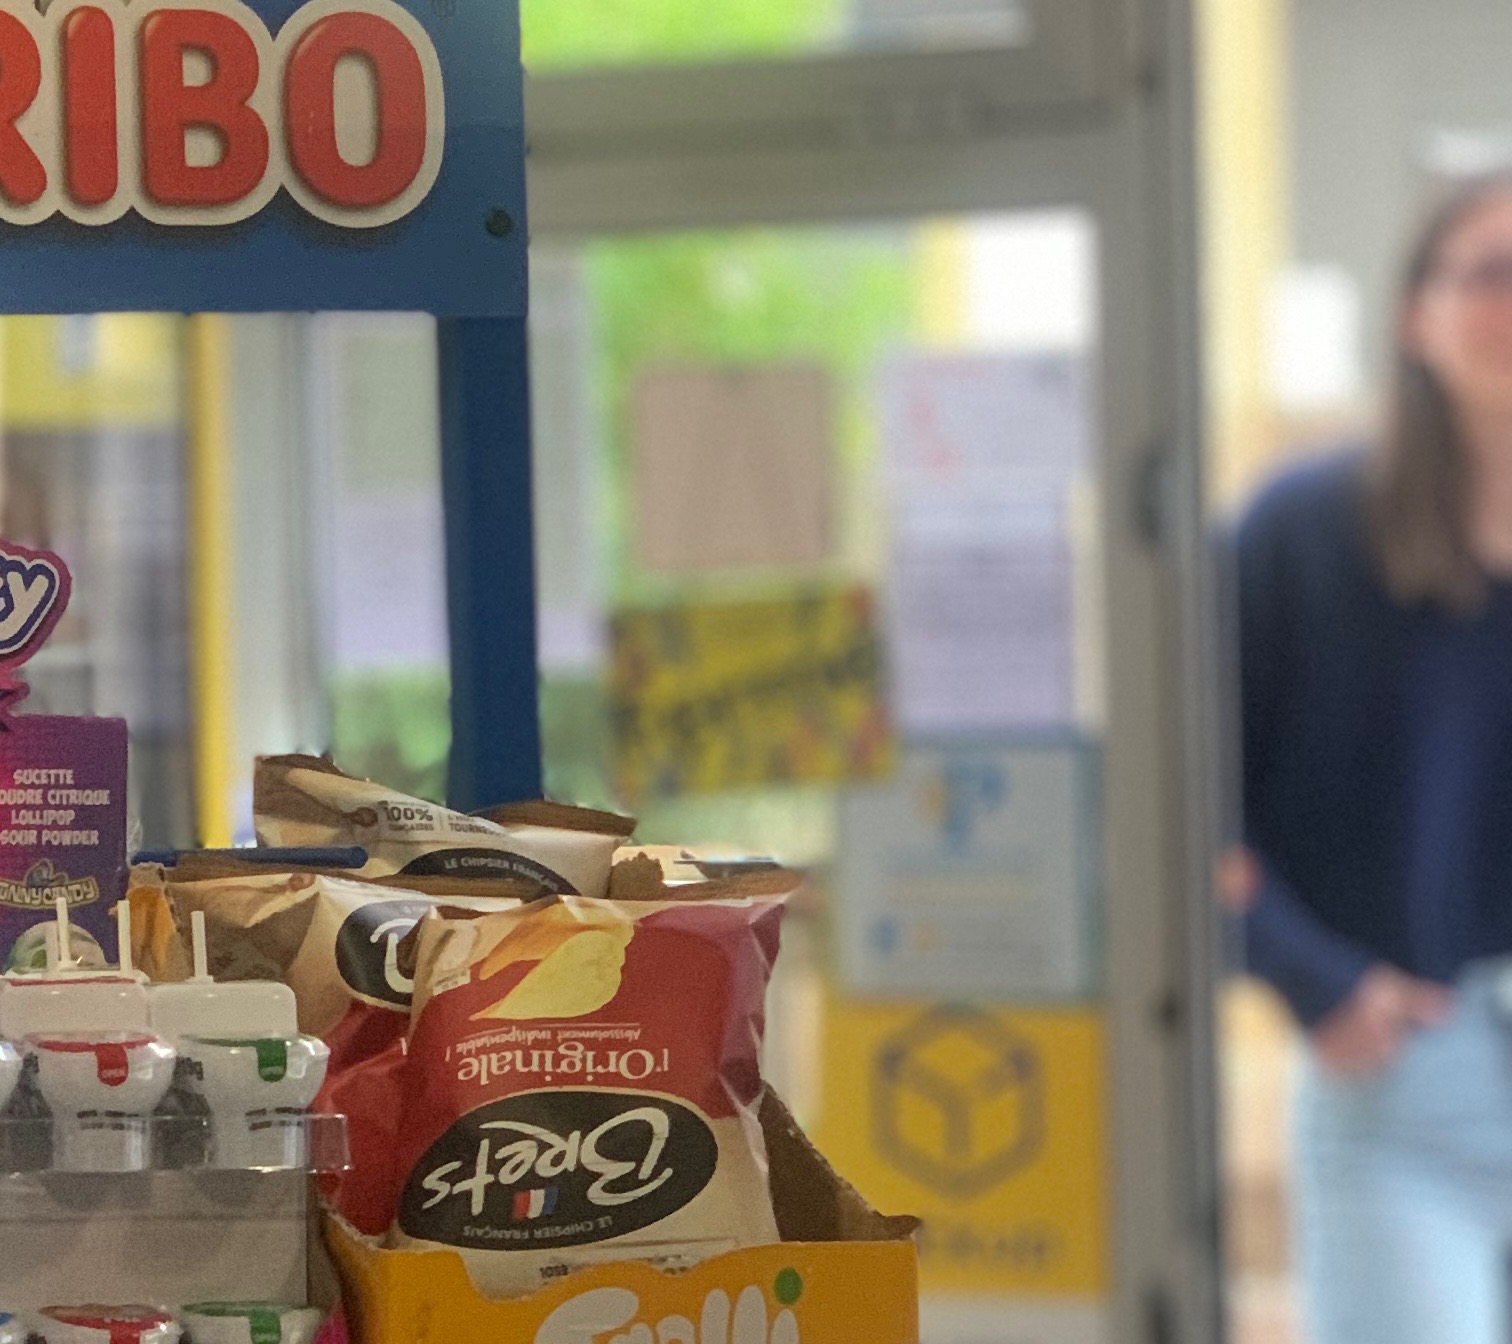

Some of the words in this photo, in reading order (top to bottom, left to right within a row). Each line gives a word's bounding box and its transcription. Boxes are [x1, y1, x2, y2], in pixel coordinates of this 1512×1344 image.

[13, 768, 75, 785] SUCETTE
[47, 789, 110, 805] CITRIQUE
[10, 809, 76, 825] LOLLIPOP
[0, 829, 37, 846] SOUR
[41, 829, 99, 845] POWDER
